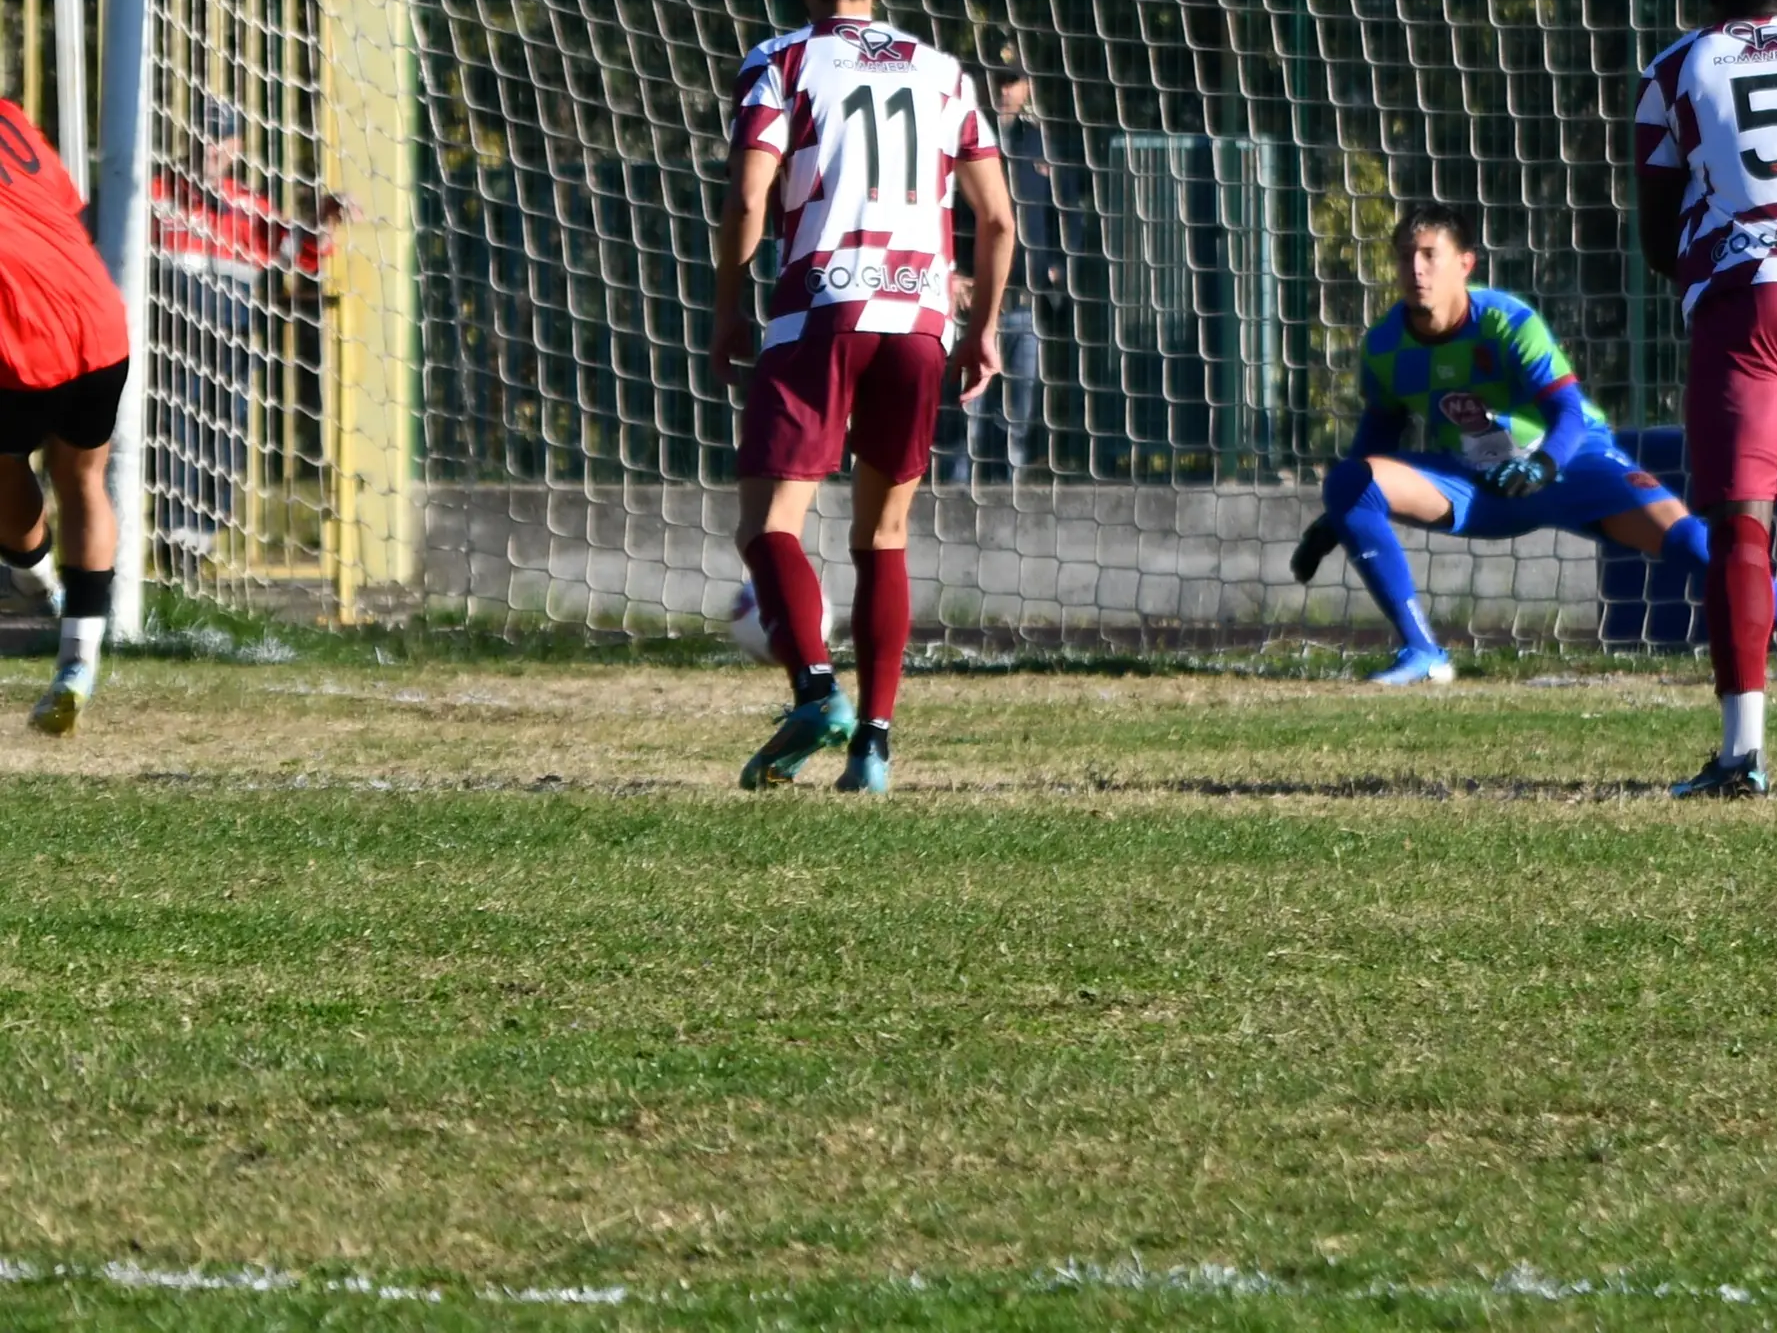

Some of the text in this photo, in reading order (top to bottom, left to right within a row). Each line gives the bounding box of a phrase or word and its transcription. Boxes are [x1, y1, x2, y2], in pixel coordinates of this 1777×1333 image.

[833, 58, 919, 73] ROMANERIA
[842, 84, 919, 204] 11
[805, 265, 942, 297] CO.GI.GAS
